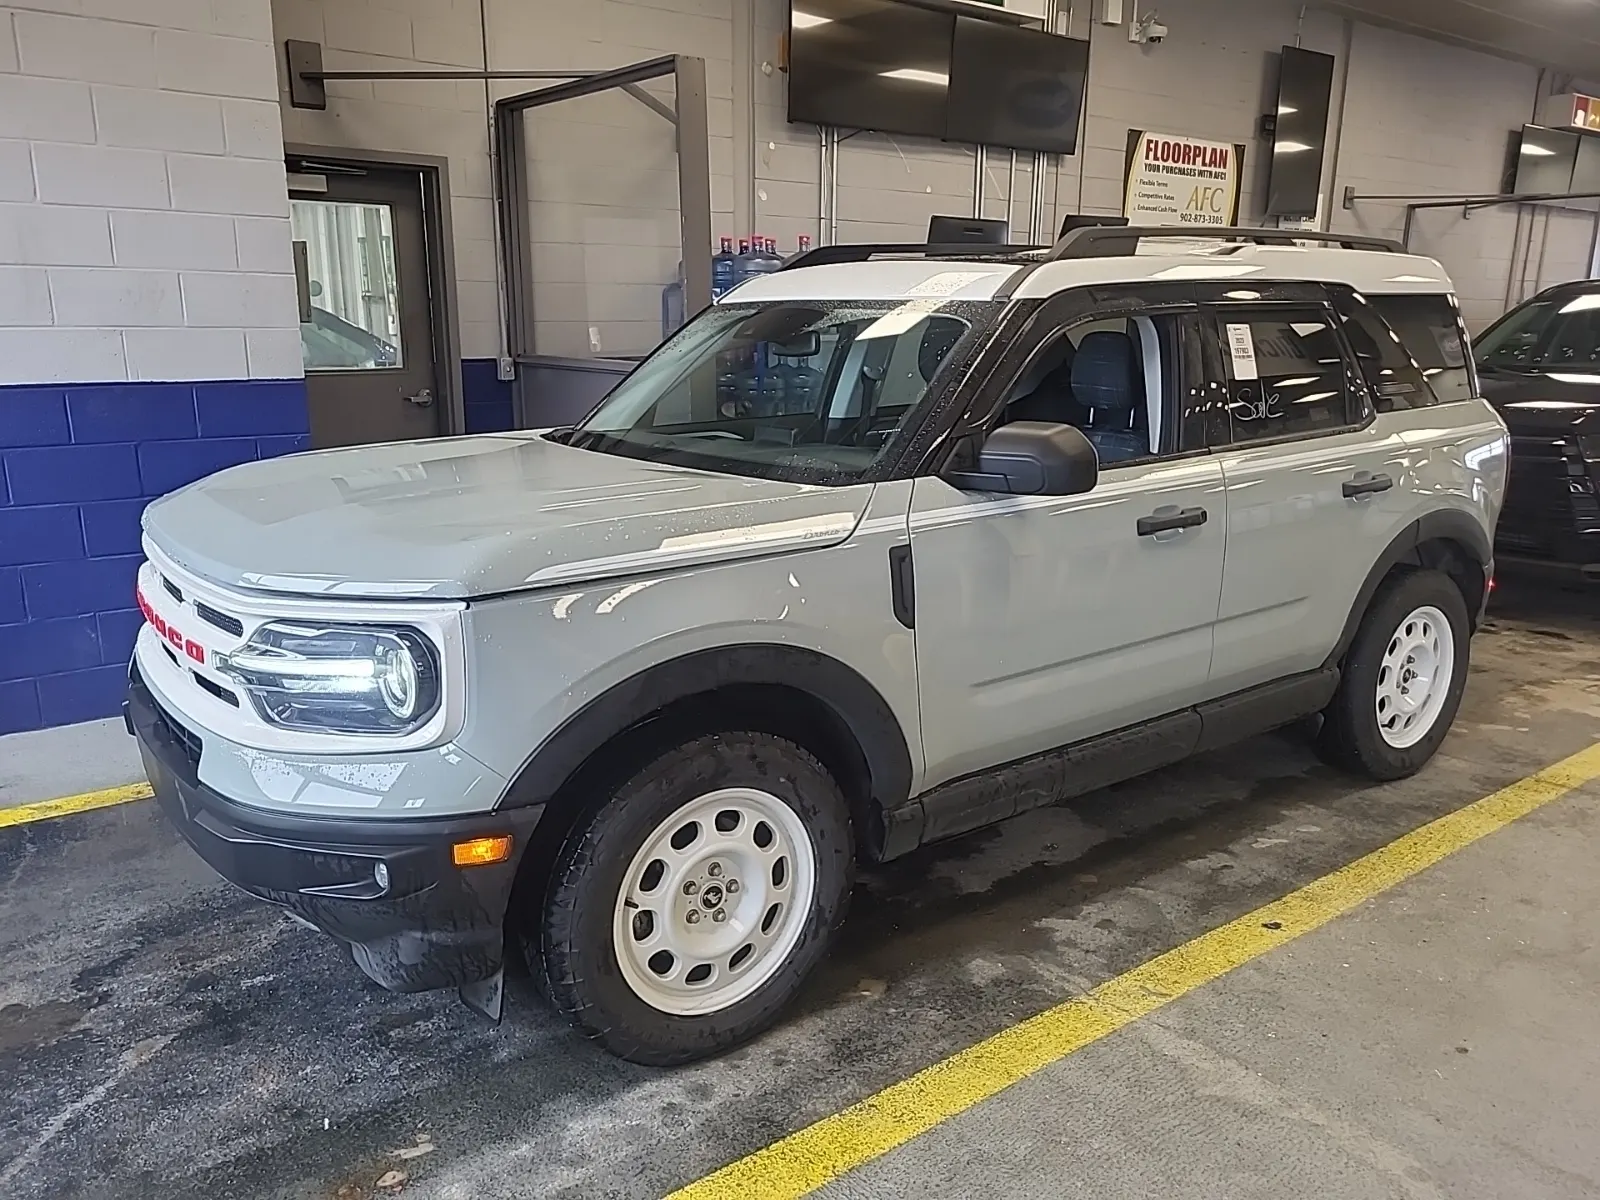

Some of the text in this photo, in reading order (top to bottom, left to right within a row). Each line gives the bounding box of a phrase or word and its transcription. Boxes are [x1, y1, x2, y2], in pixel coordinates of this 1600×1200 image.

[1144, 139, 1228, 169] FLOORPLAN
[1144, 163, 1161, 173] YOUR
[1161, 165, 1197, 177] PURCHASES
[1197, 168, 1213, 179] WITH
[1139, 179, 1169, 188] Flexible Terms
[1138, 192, 1163, 200] Competitive
[1185, 186, 1224, 213] AFC
[1137, 204, 1158, 212] Enhanced
[1180, 213, 1223, 225] 902-873-3305
[1234, 379, 1284, 421] Sale
[802, 528, 841, 540] Bronco
